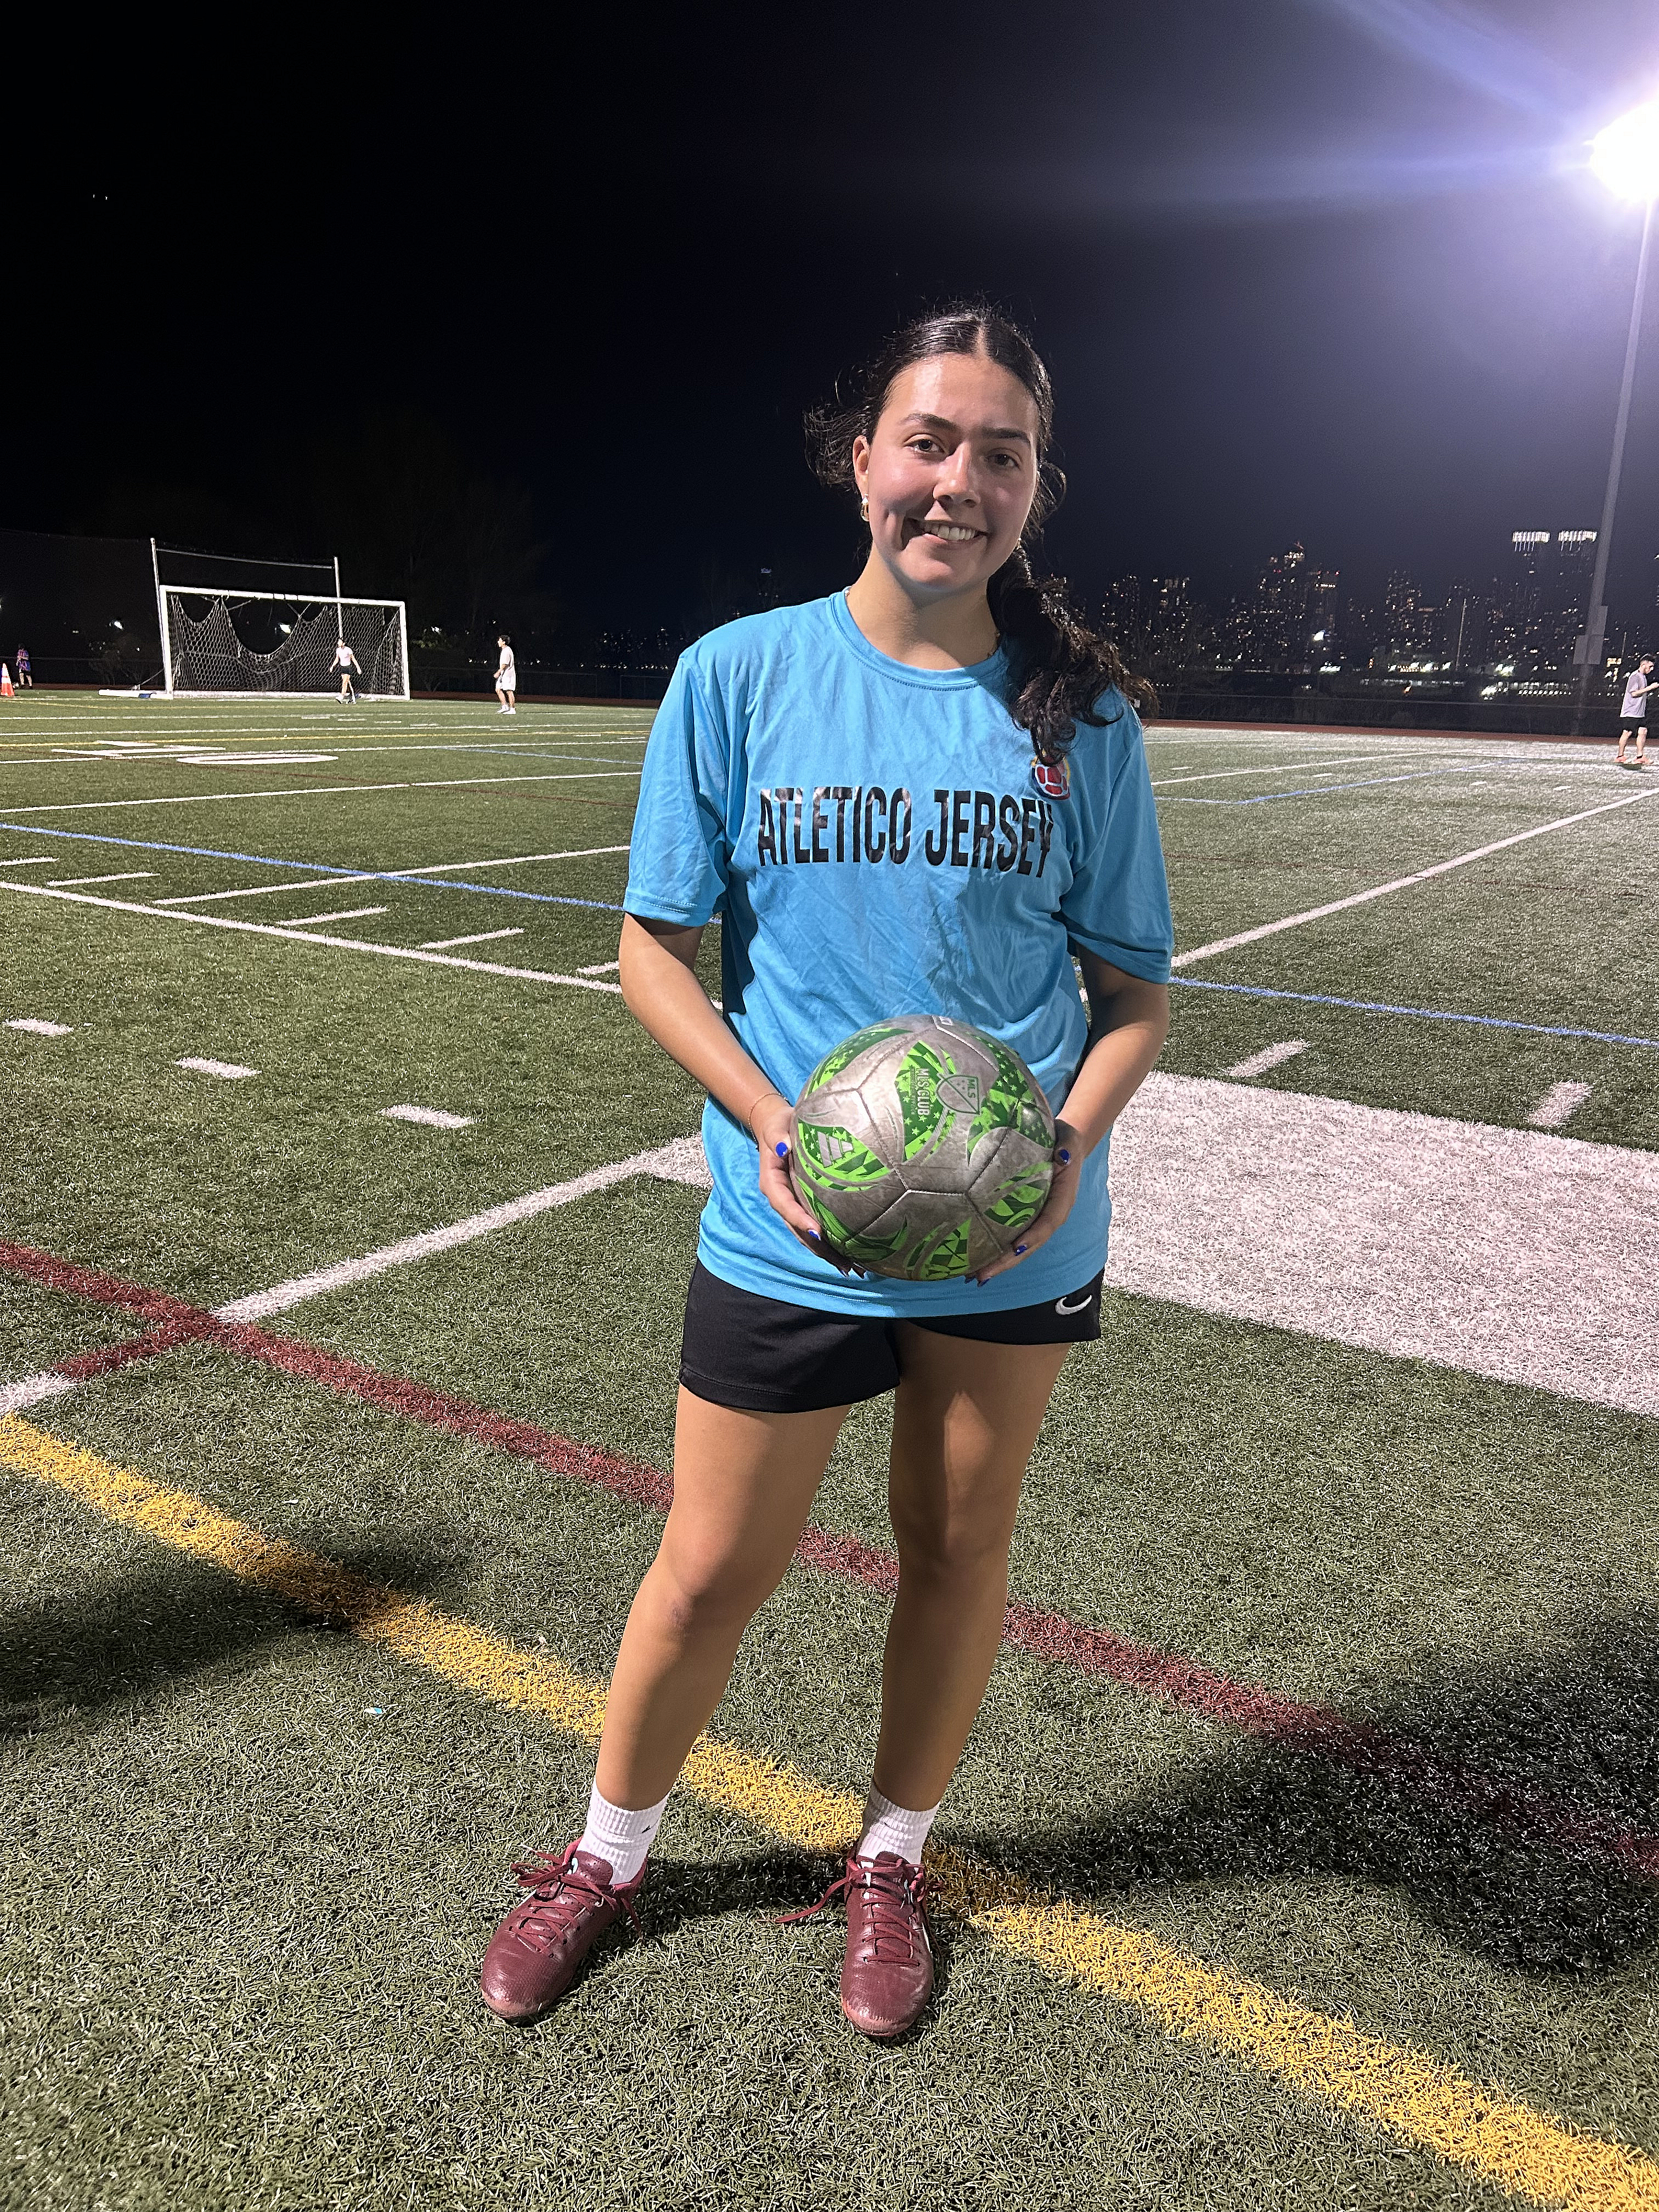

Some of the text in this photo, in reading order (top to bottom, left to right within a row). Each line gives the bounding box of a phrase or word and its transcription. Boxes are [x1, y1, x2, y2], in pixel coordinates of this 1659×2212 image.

[758, 786, 1053, 878] ATLETICO JERSEY
[916, 1068, 930, 1115] MLS CLUB
[967, 1079, 976, 1098] MLS
